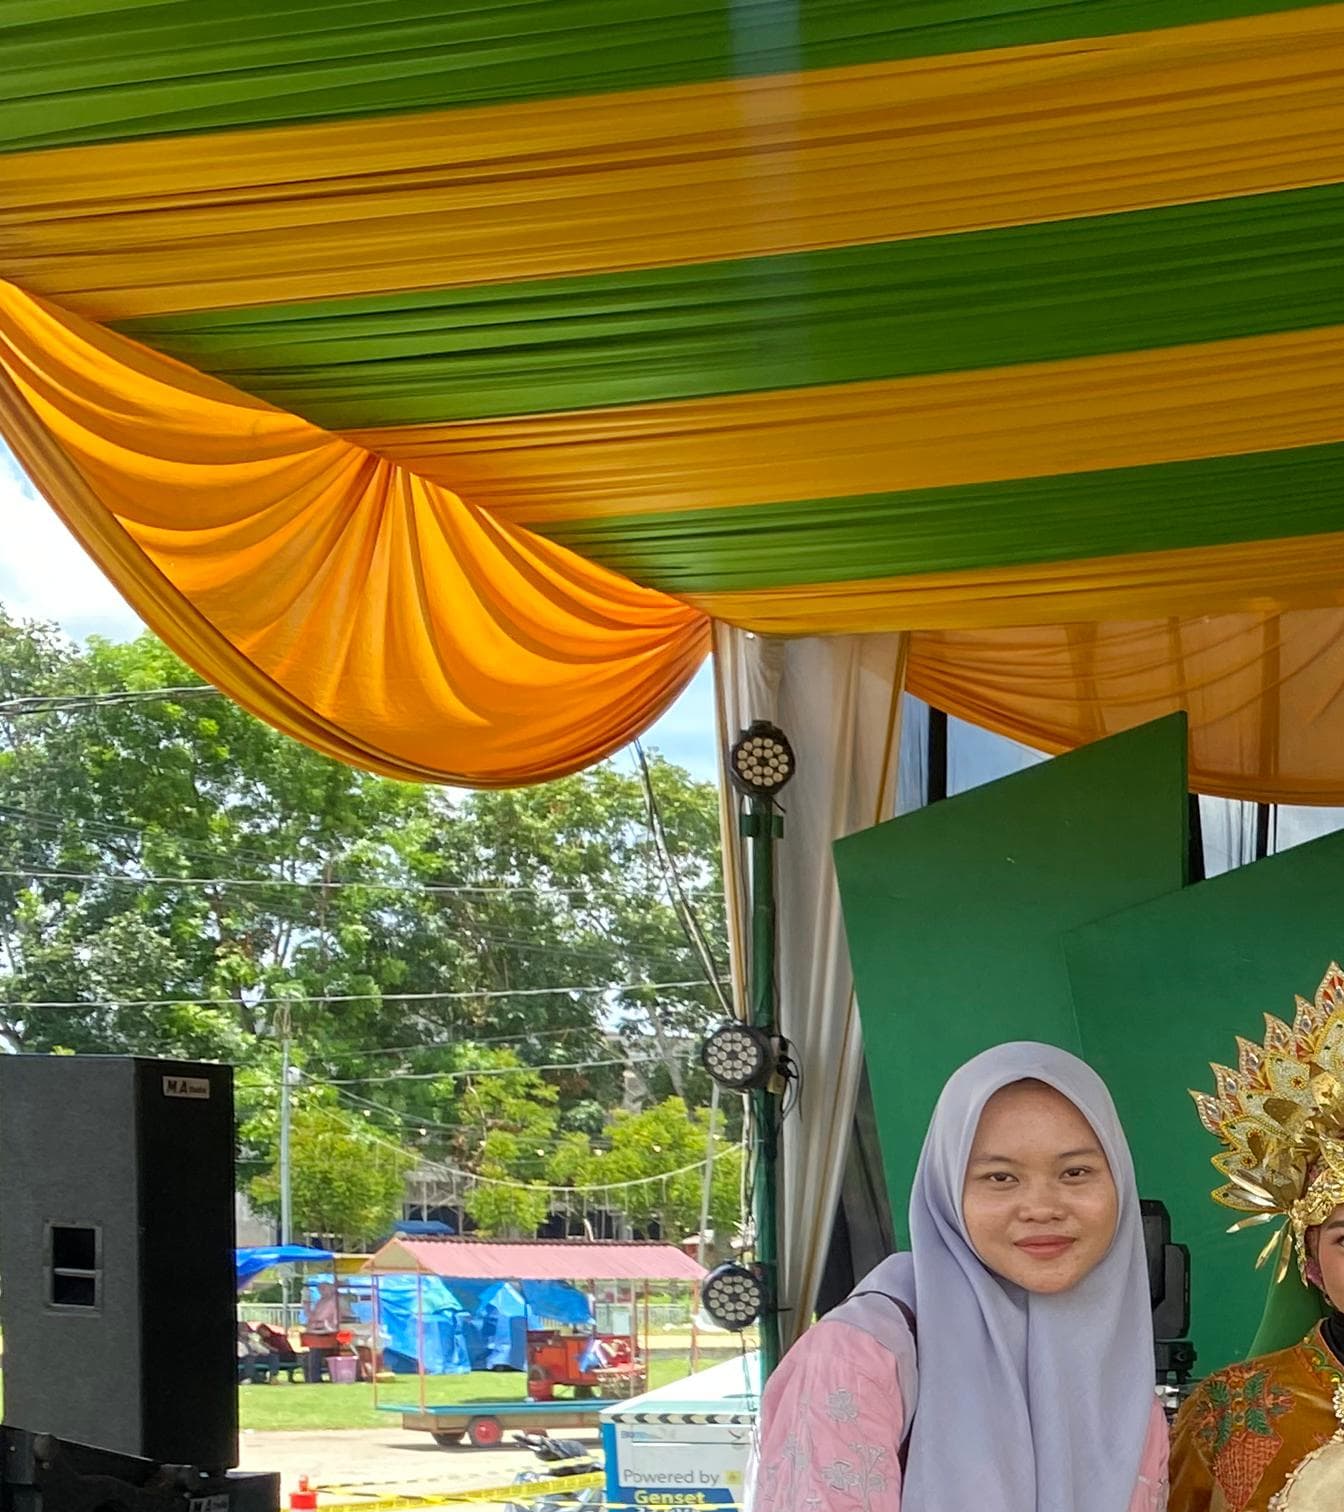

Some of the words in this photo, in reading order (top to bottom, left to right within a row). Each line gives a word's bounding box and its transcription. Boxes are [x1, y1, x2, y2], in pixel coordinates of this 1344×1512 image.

[623, 1469, 695, 1484] Powered
[699, 1469, 720, 1486] by
[634, 1489, 706, 1505] Genset
